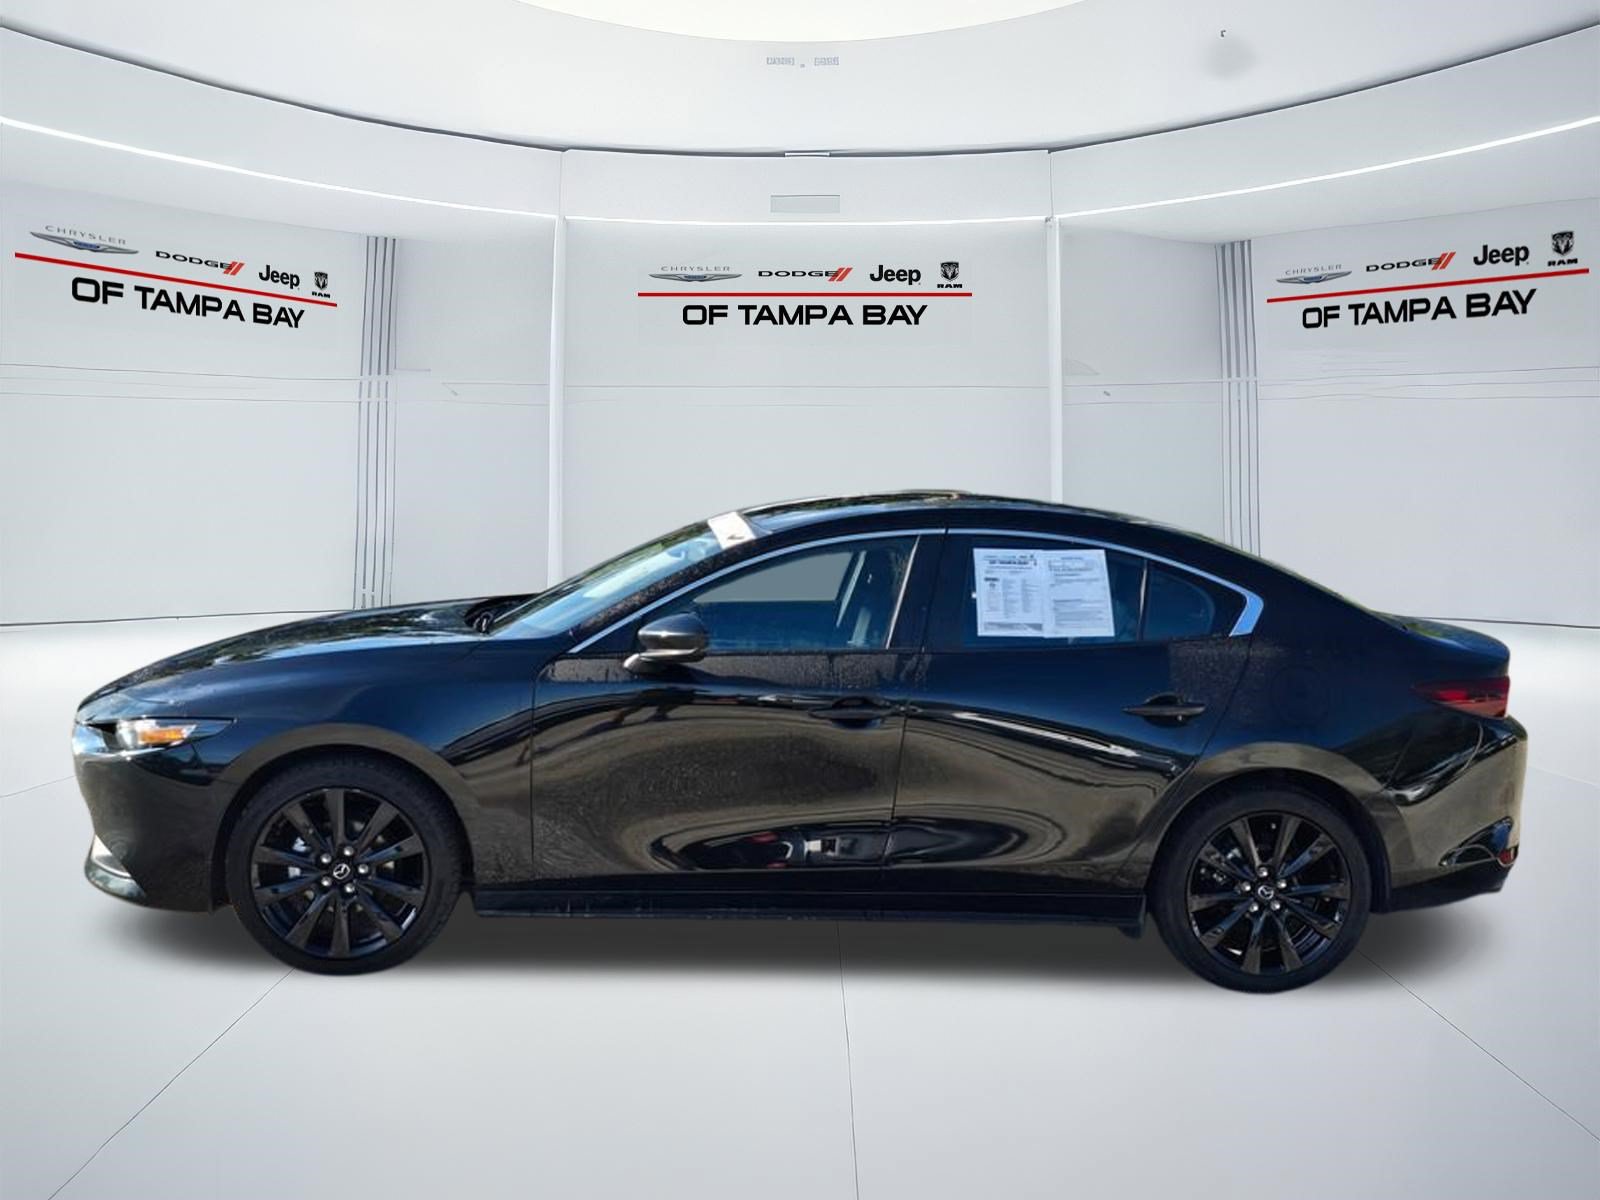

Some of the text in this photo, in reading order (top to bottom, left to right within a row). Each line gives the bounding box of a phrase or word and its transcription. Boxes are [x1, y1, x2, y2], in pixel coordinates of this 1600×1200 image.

[45, 225, 331, 299] CHRYSLER DODGE Jeep RAM
[757, 269, 839, 278] DODGE
[869, 264, 922, 286] Jeep
[1285, 244, 1579, 276] CHRYSLER DODGE Jeep RAM
[71, 276, 305, 329] OF TAMPA BAY
[682, 304, 929, 326] OF TAMPA BAY
[1302, 288, 1537, 330] OF TAMPA BAY
